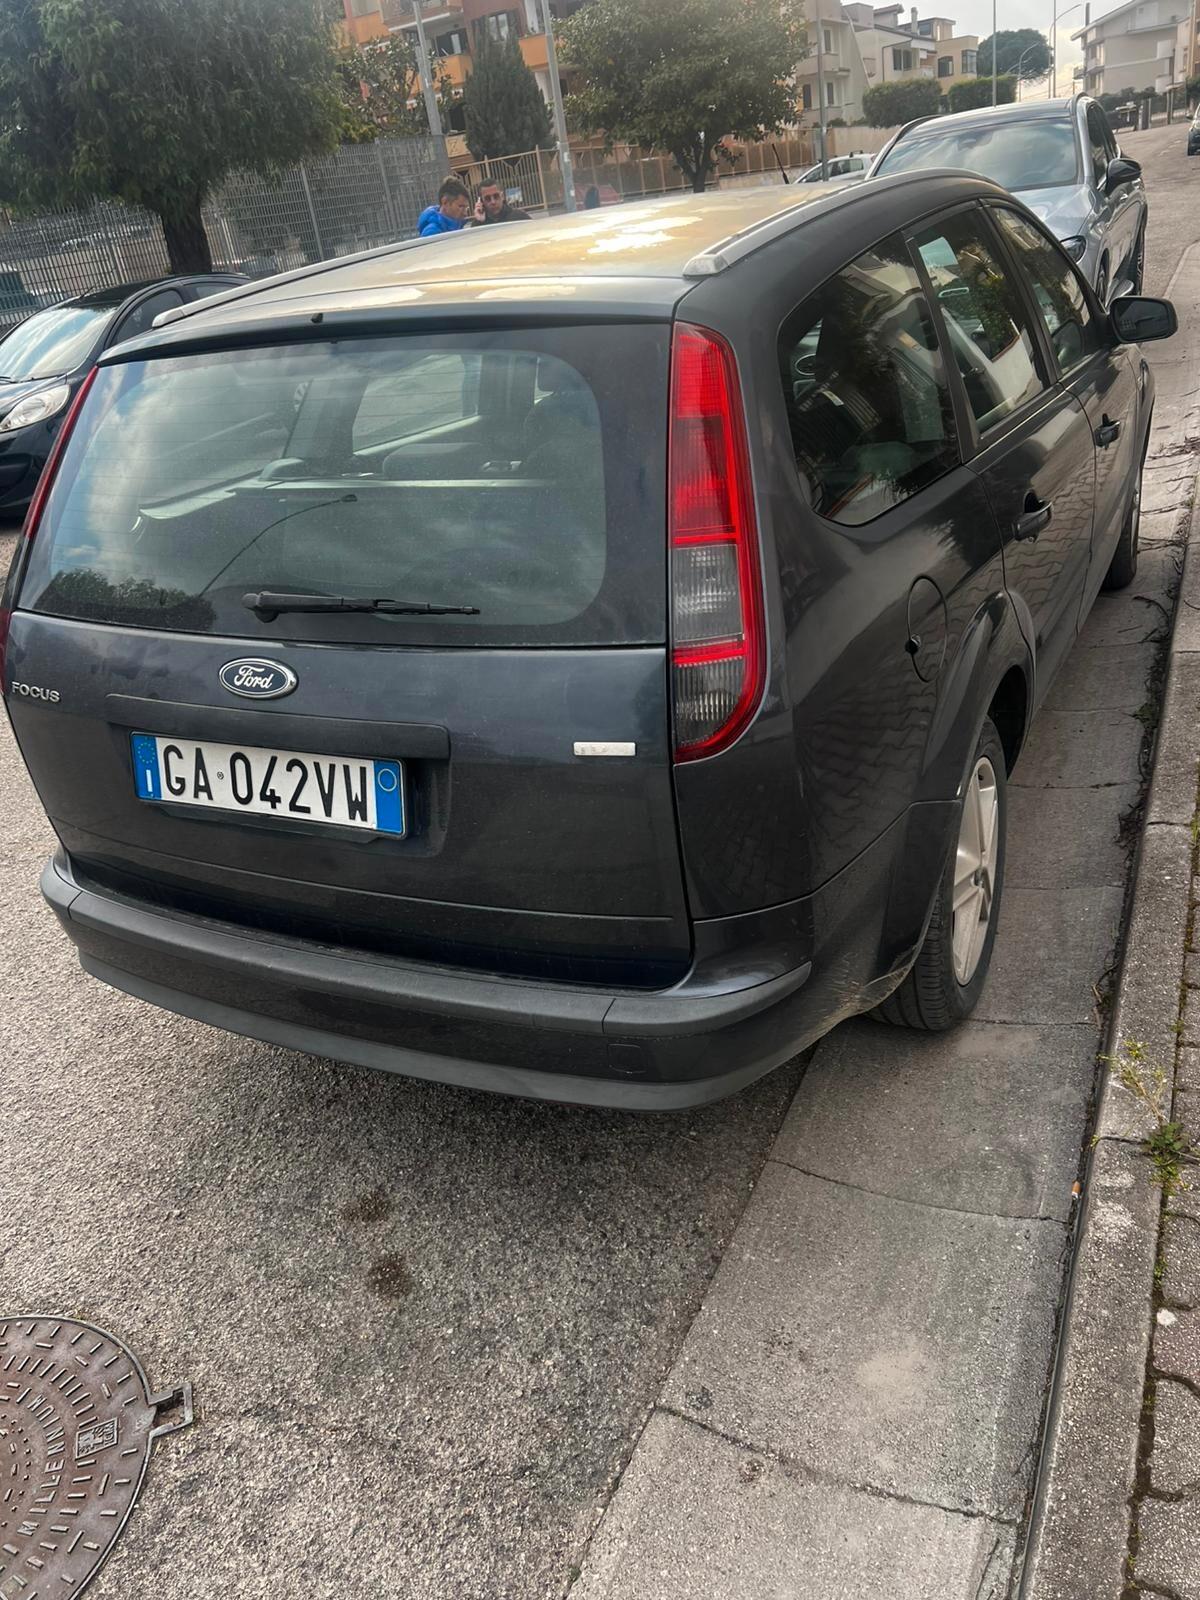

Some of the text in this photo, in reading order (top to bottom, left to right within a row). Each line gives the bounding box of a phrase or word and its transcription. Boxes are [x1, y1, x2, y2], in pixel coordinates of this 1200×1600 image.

[234, 665, 274, 689] Ford
[12, 681, 60, 702] FOCUS
[17, 1394, 66, 1537] MILLENNIUM
